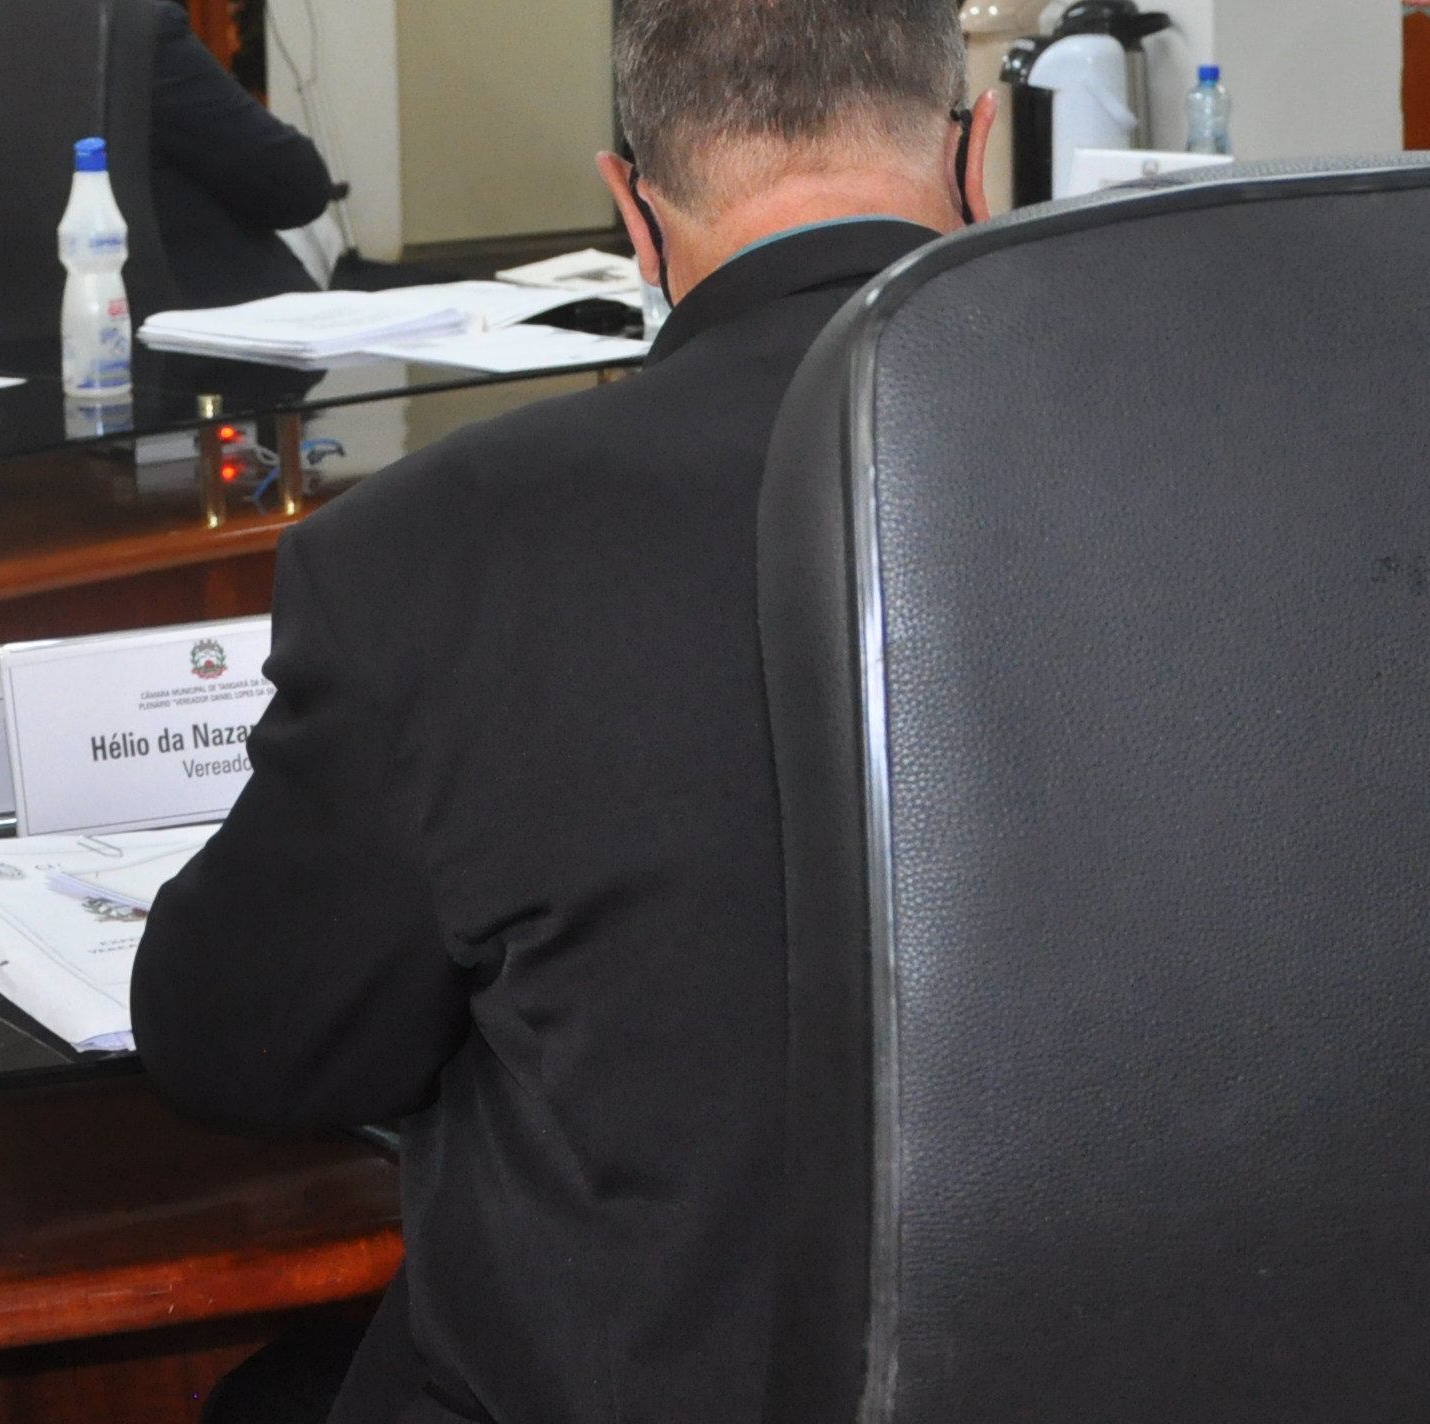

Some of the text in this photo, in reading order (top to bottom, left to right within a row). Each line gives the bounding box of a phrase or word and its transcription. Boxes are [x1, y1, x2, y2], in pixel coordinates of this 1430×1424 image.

[90, 721, 256, 762] Hélio da Naza
[182, 753, 254, 779] Vereado
